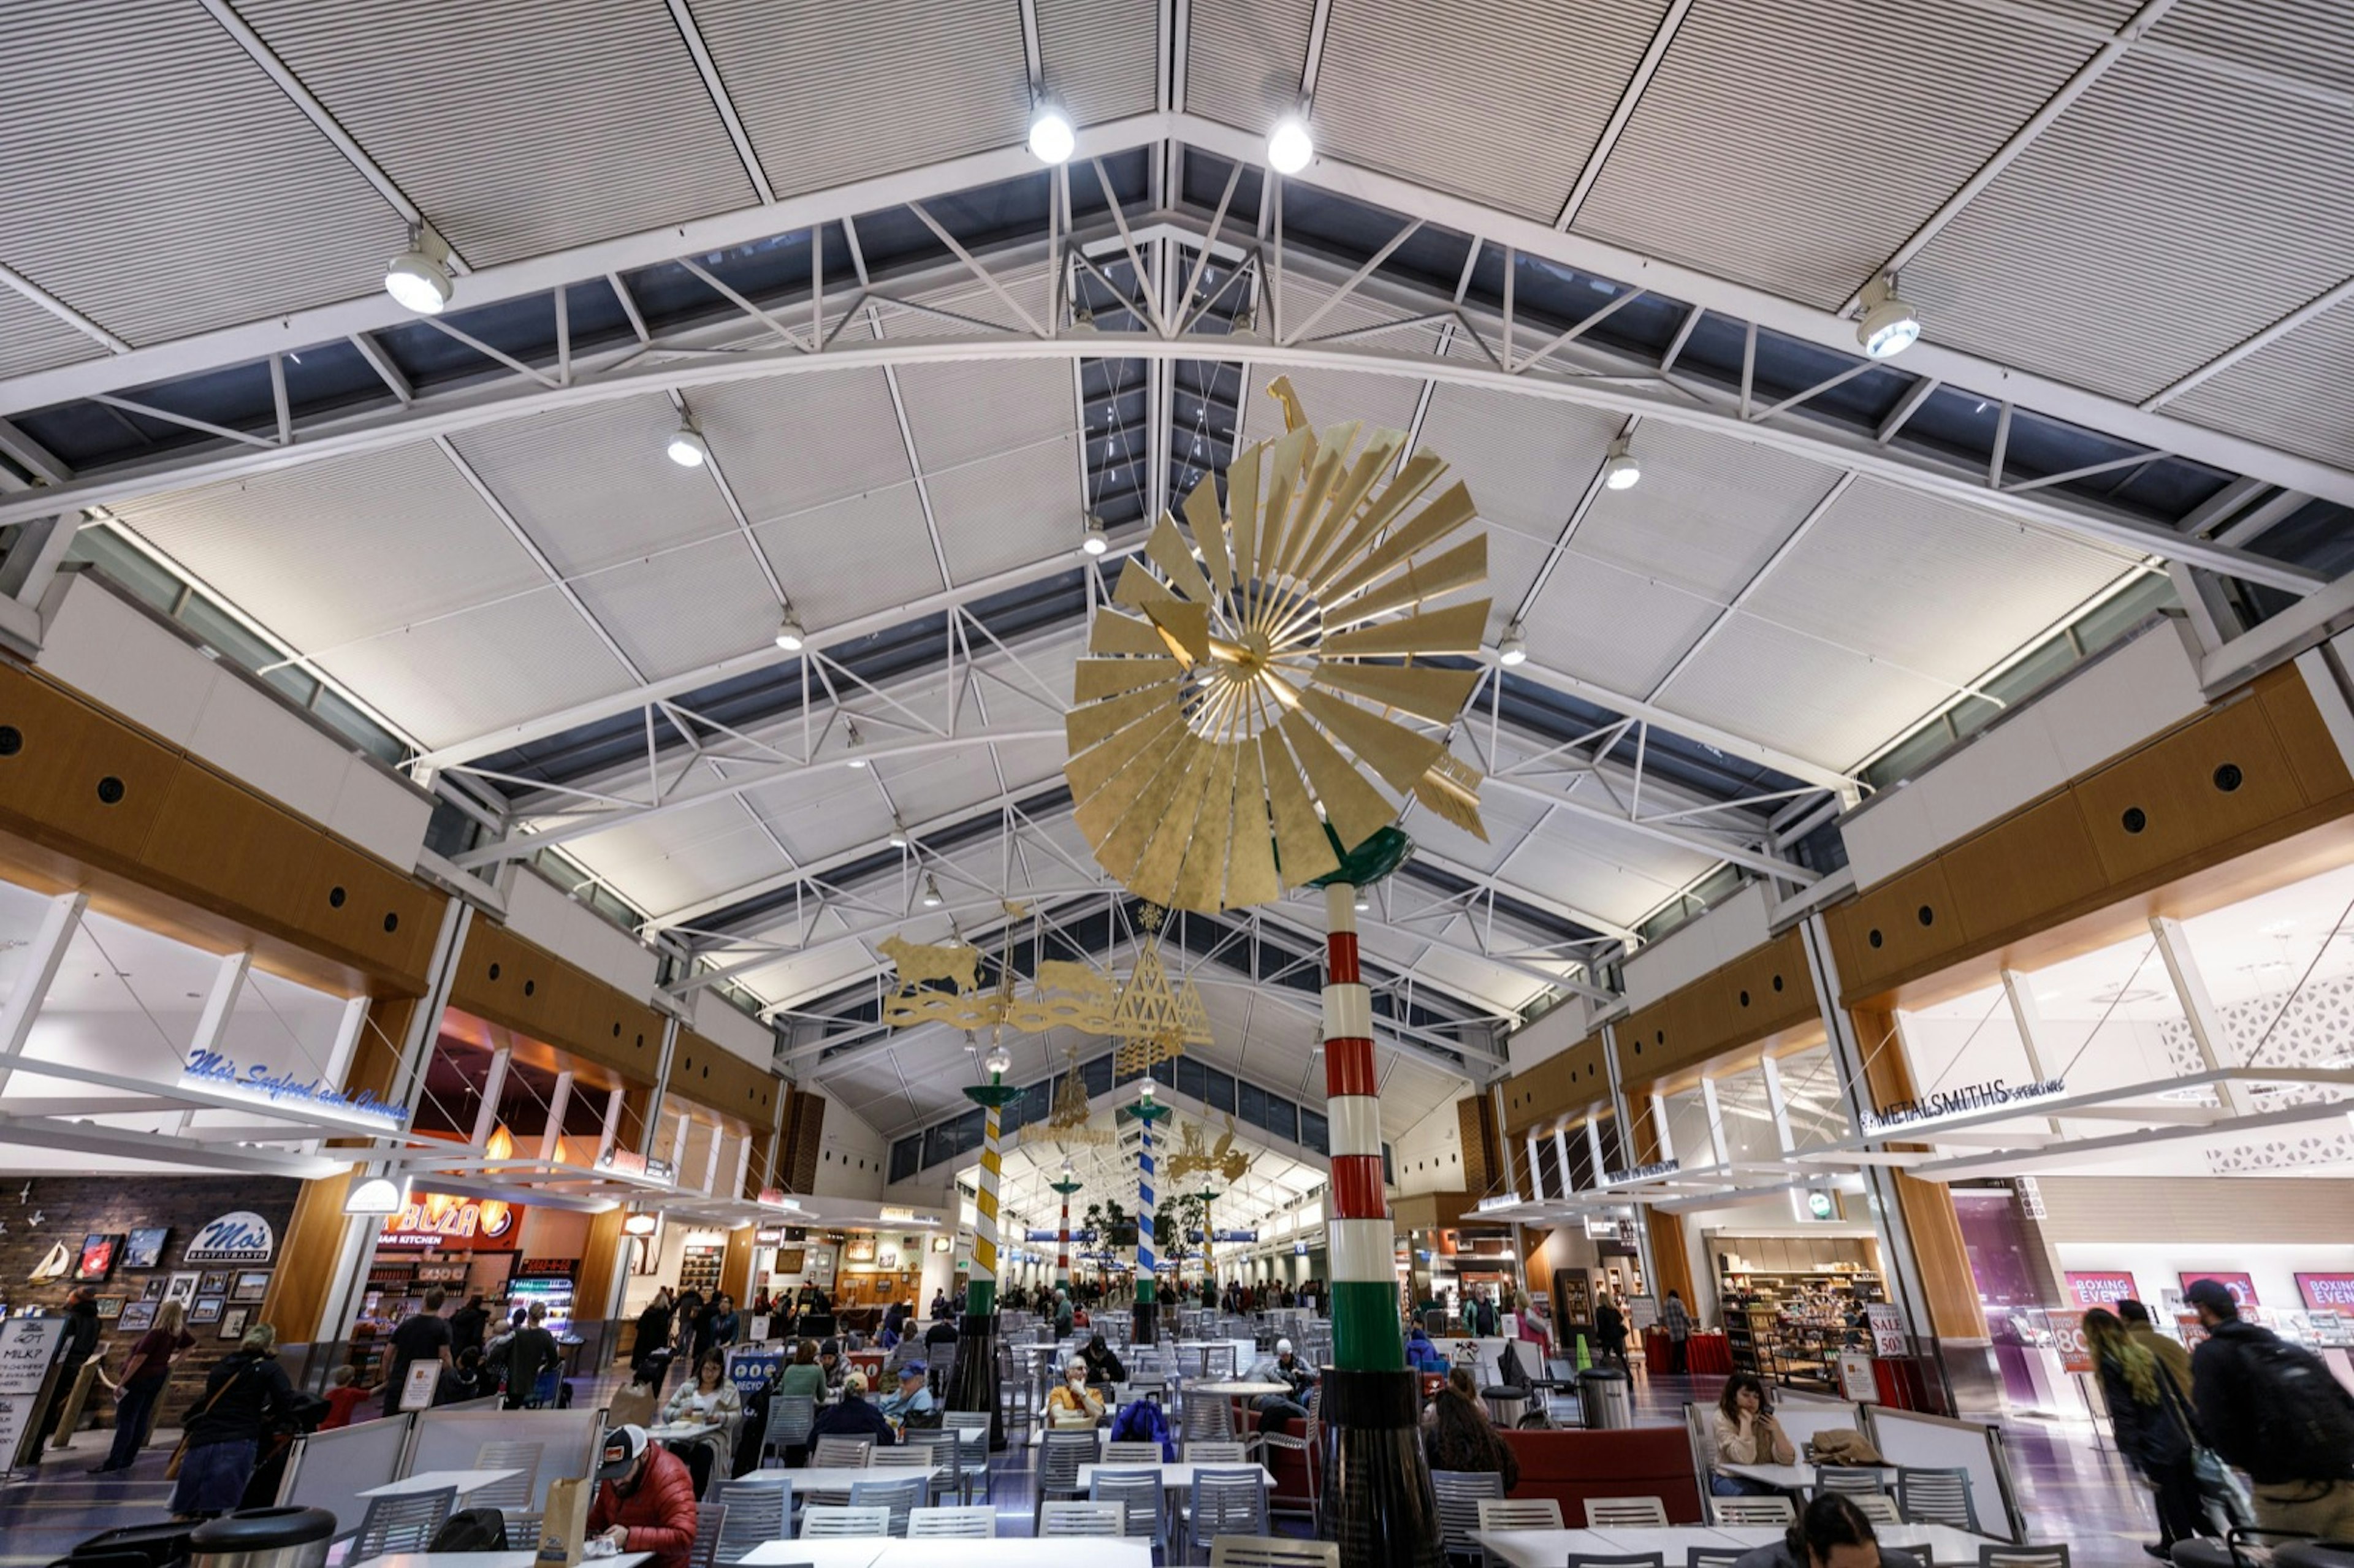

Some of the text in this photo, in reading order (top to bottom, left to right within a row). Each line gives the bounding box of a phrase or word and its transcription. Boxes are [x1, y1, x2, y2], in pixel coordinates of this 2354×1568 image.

[184, 1049, 236, 1081] Mo's
[235, 1065, 318, 1100] Seafood
[1874, 1079, 2008, 1128] METALSMITHS
[204, 1222, 267, 1250] Mo's
[398, 1235, 442, 1245] KITCHEN
[189, 1250, 267, 1259] RESTAURANTS
[2075, 1279, 2128, 1291] BOXING
[2079, 1290, 2130, 1303] EVENT
[1872, 1319, 1902, 1331] SALE
[13, 1334, 45, 1344] GOT
[4, 1349, 43, 1359] MILK?
